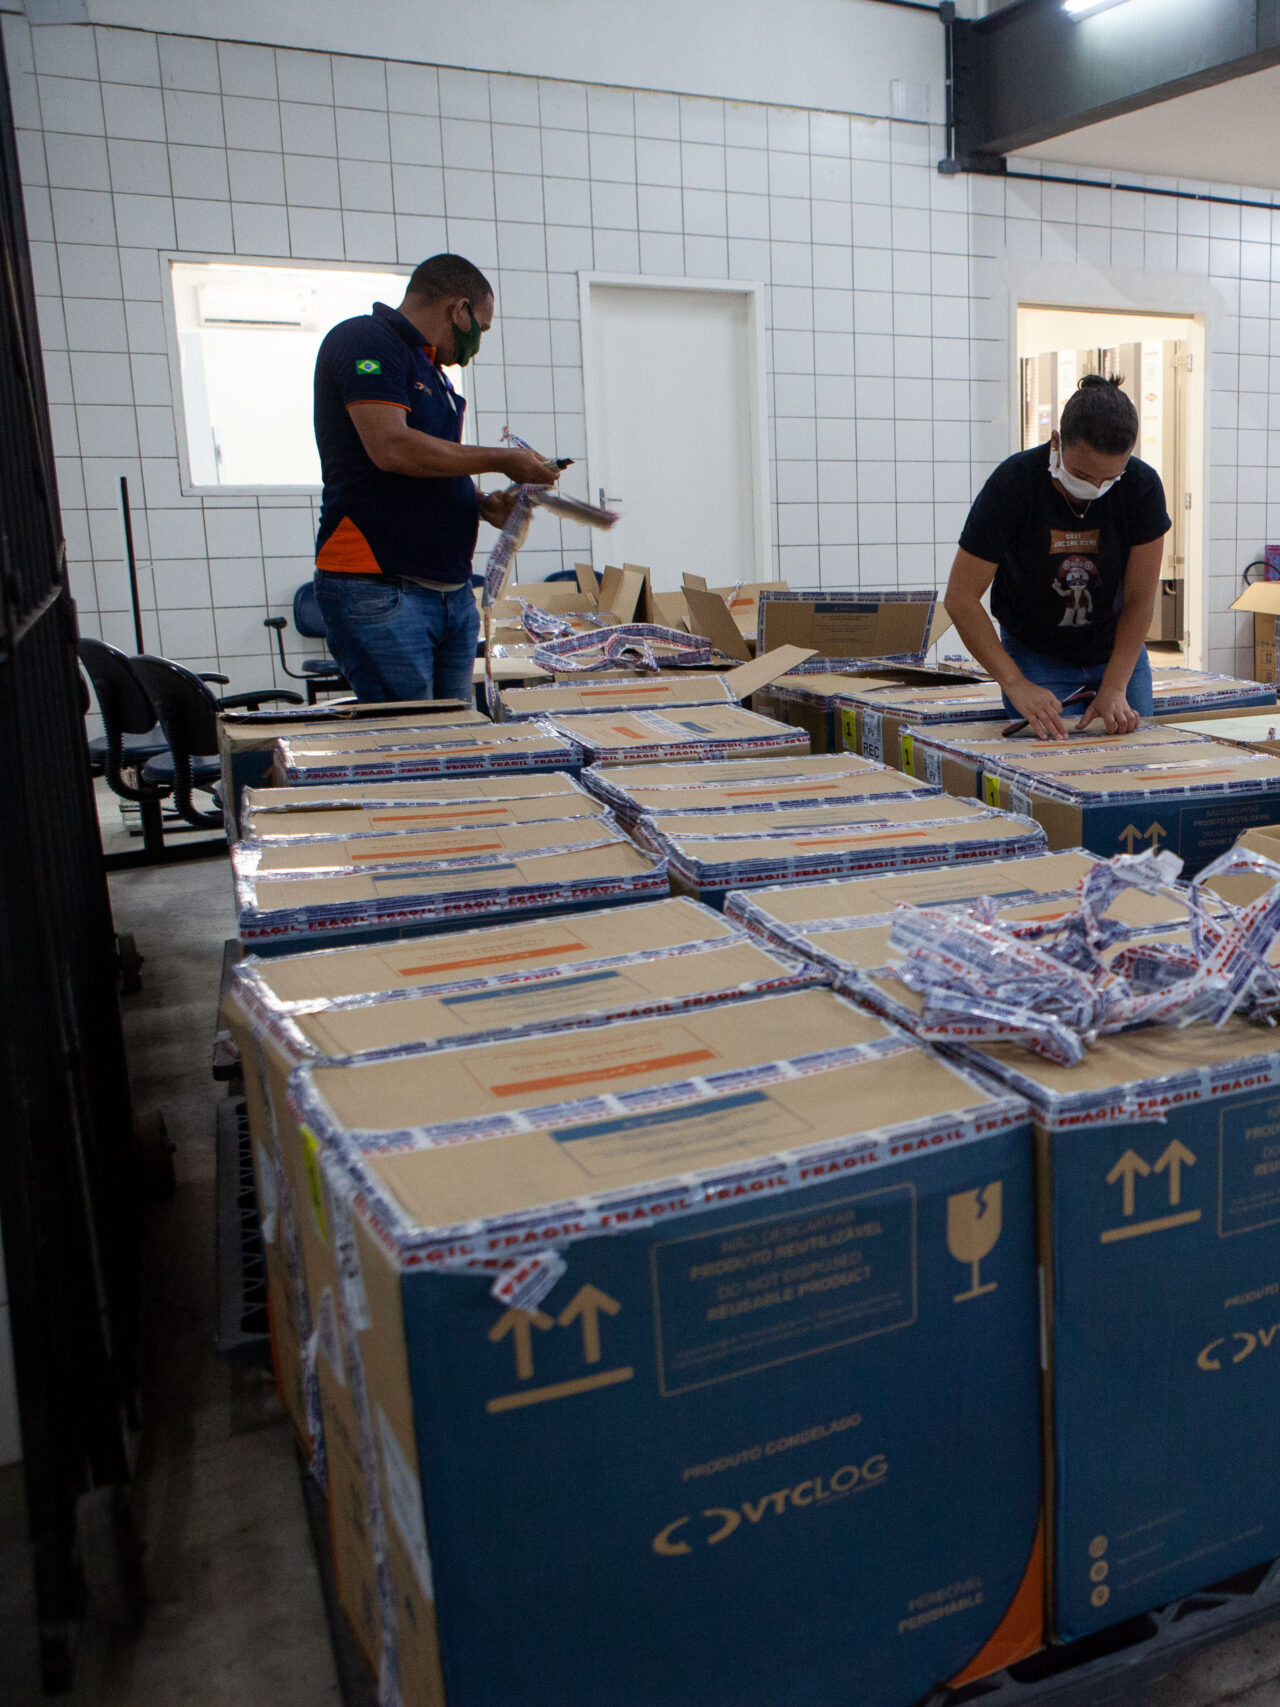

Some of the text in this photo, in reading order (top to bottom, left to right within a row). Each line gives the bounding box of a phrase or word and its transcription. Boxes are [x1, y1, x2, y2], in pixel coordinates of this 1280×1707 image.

[845, 721, 851, 737] 1
[863, 741, 880, 759] REC
[1211, 1073, 1271, 1095] FRÁGIL
[800, 1152, 880, 1181] FRÁGIL
[890, 1129, 966, 1157] FRÁGIL
[1224, 1282, 1280, 1309] PRODUTO
[681, 1413, 862, 1482] PRODUTO CONGELADO
[741, 1453, 889, 1523] VTCLOG
